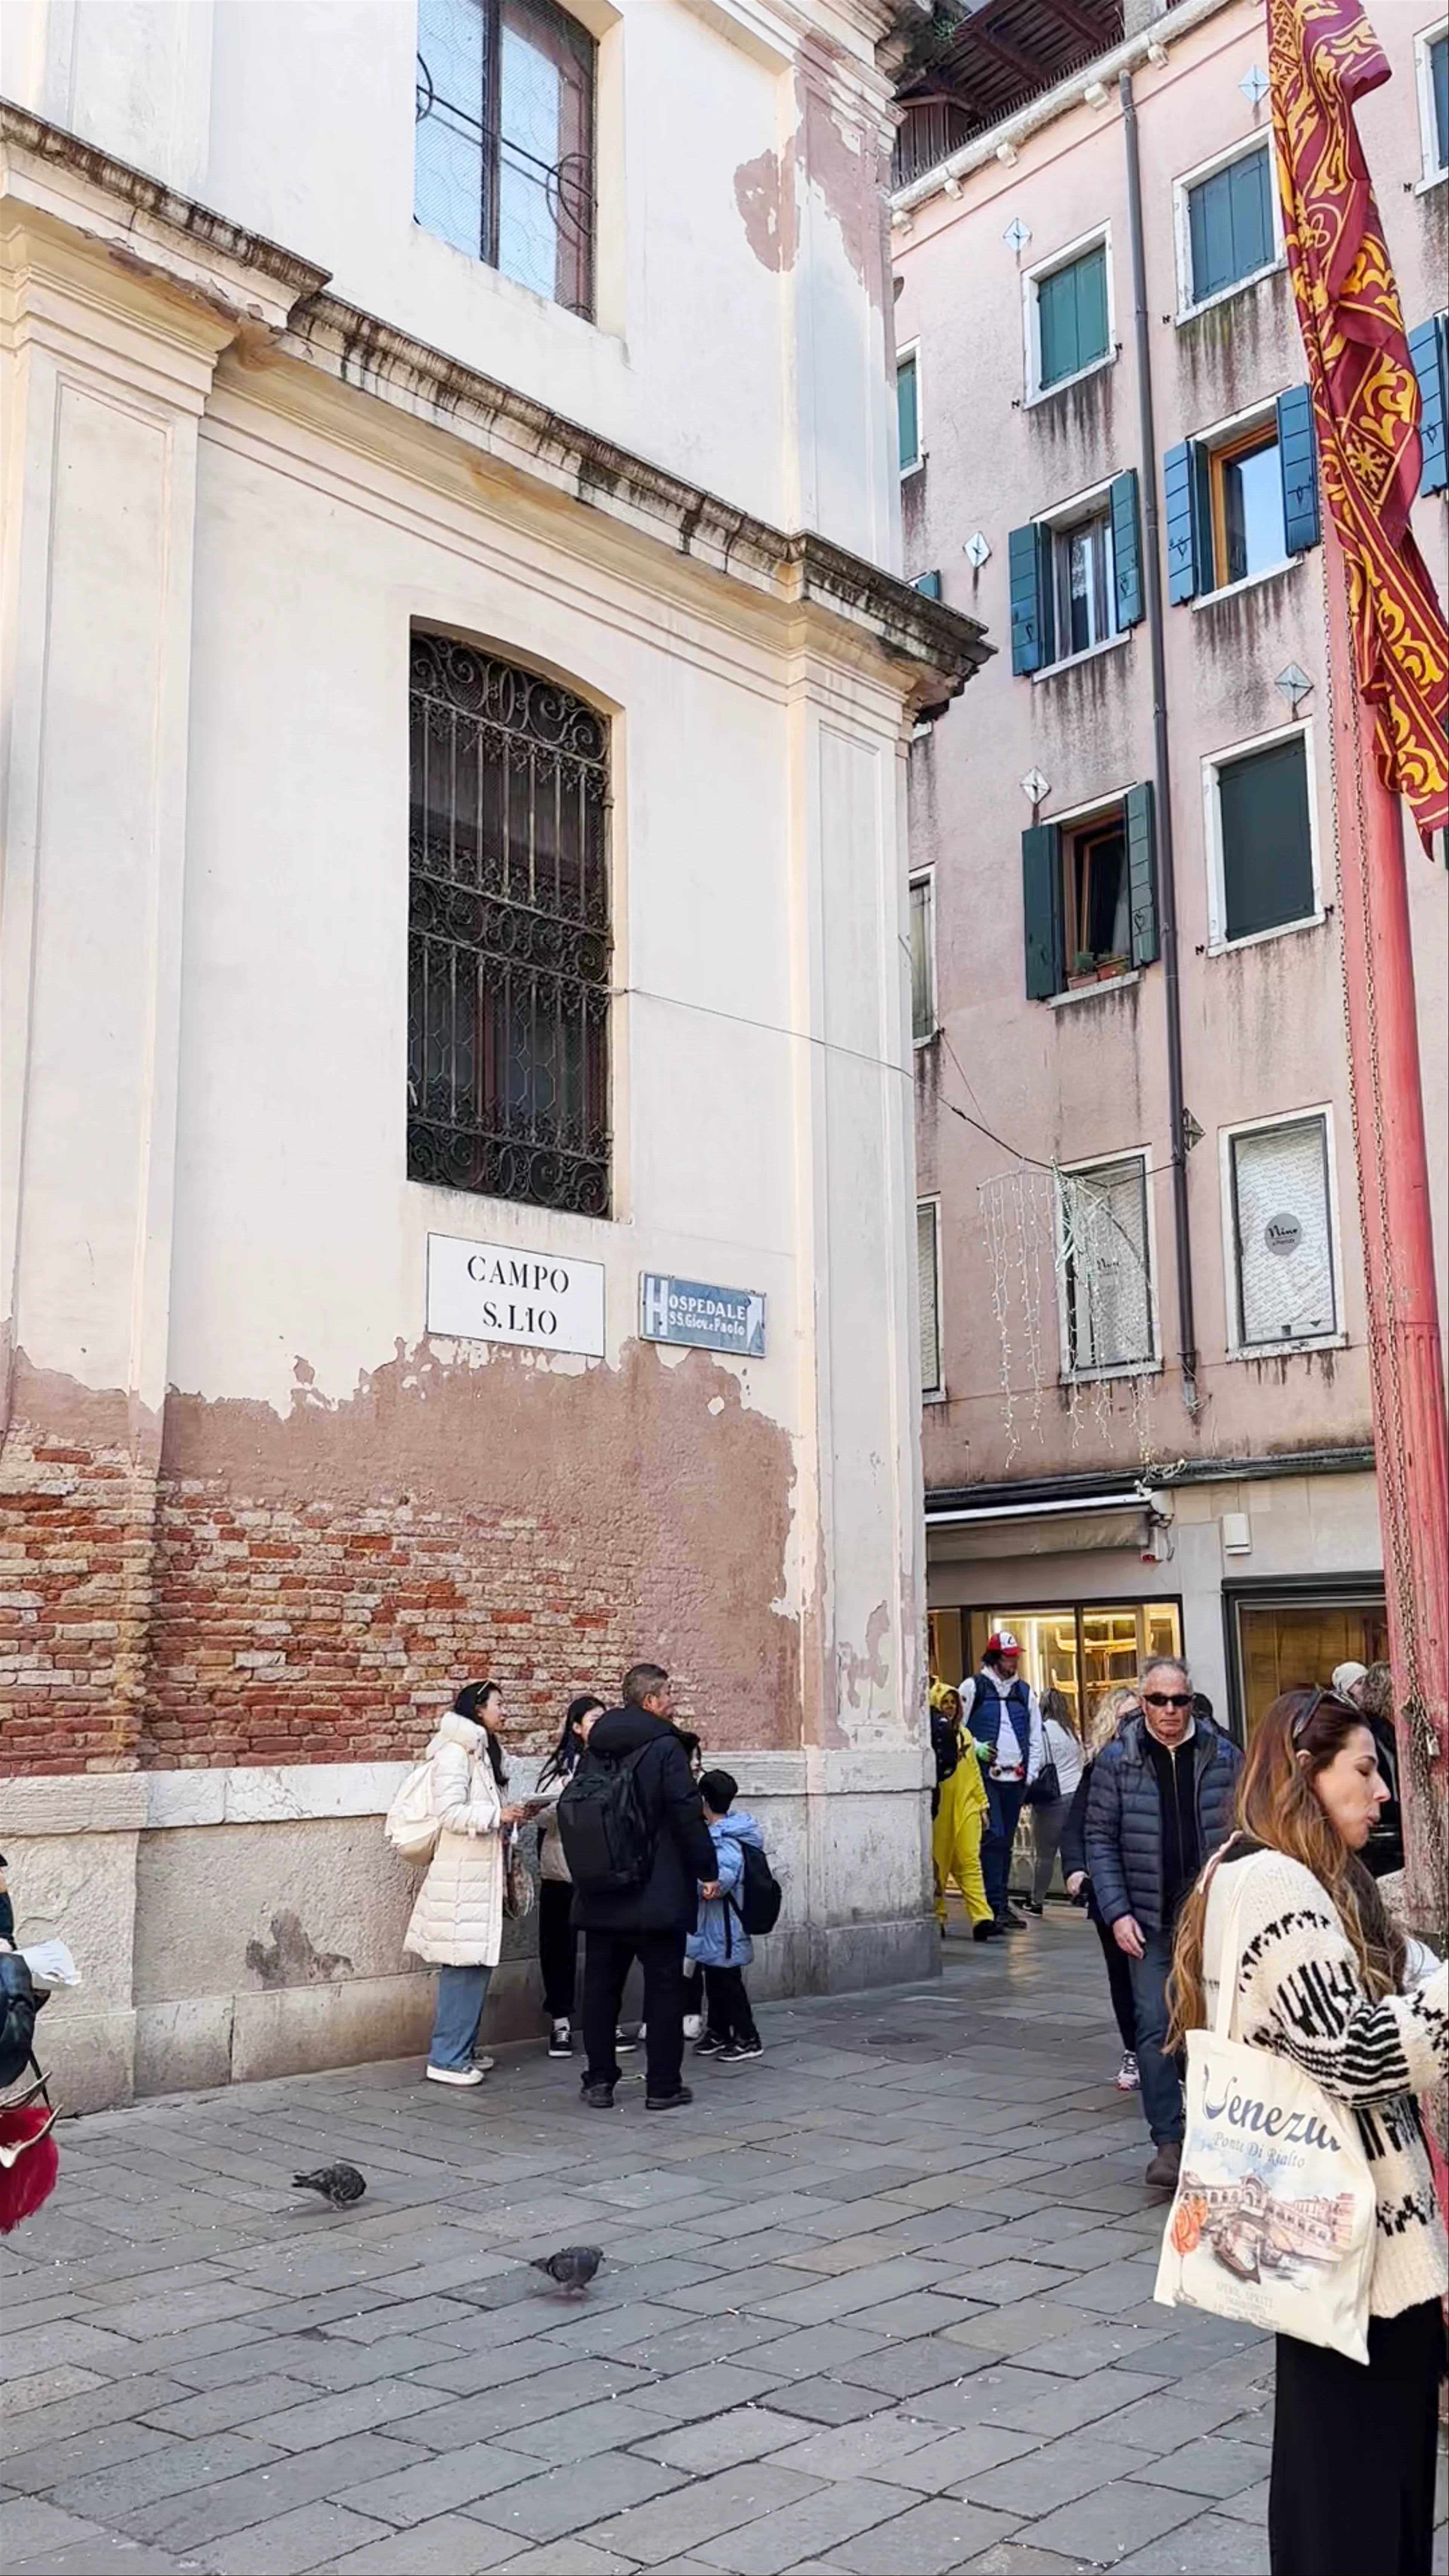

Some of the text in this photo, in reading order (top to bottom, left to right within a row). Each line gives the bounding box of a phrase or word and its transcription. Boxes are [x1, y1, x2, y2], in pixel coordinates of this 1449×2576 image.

[467, 1255, 569, 1293] CAMPO
[646, 1277, 746, 1336] HOSPEDALE
[1245, 2141, 1264, 2158] Di
[1267, 2147, 1306, 2168] Rialto
